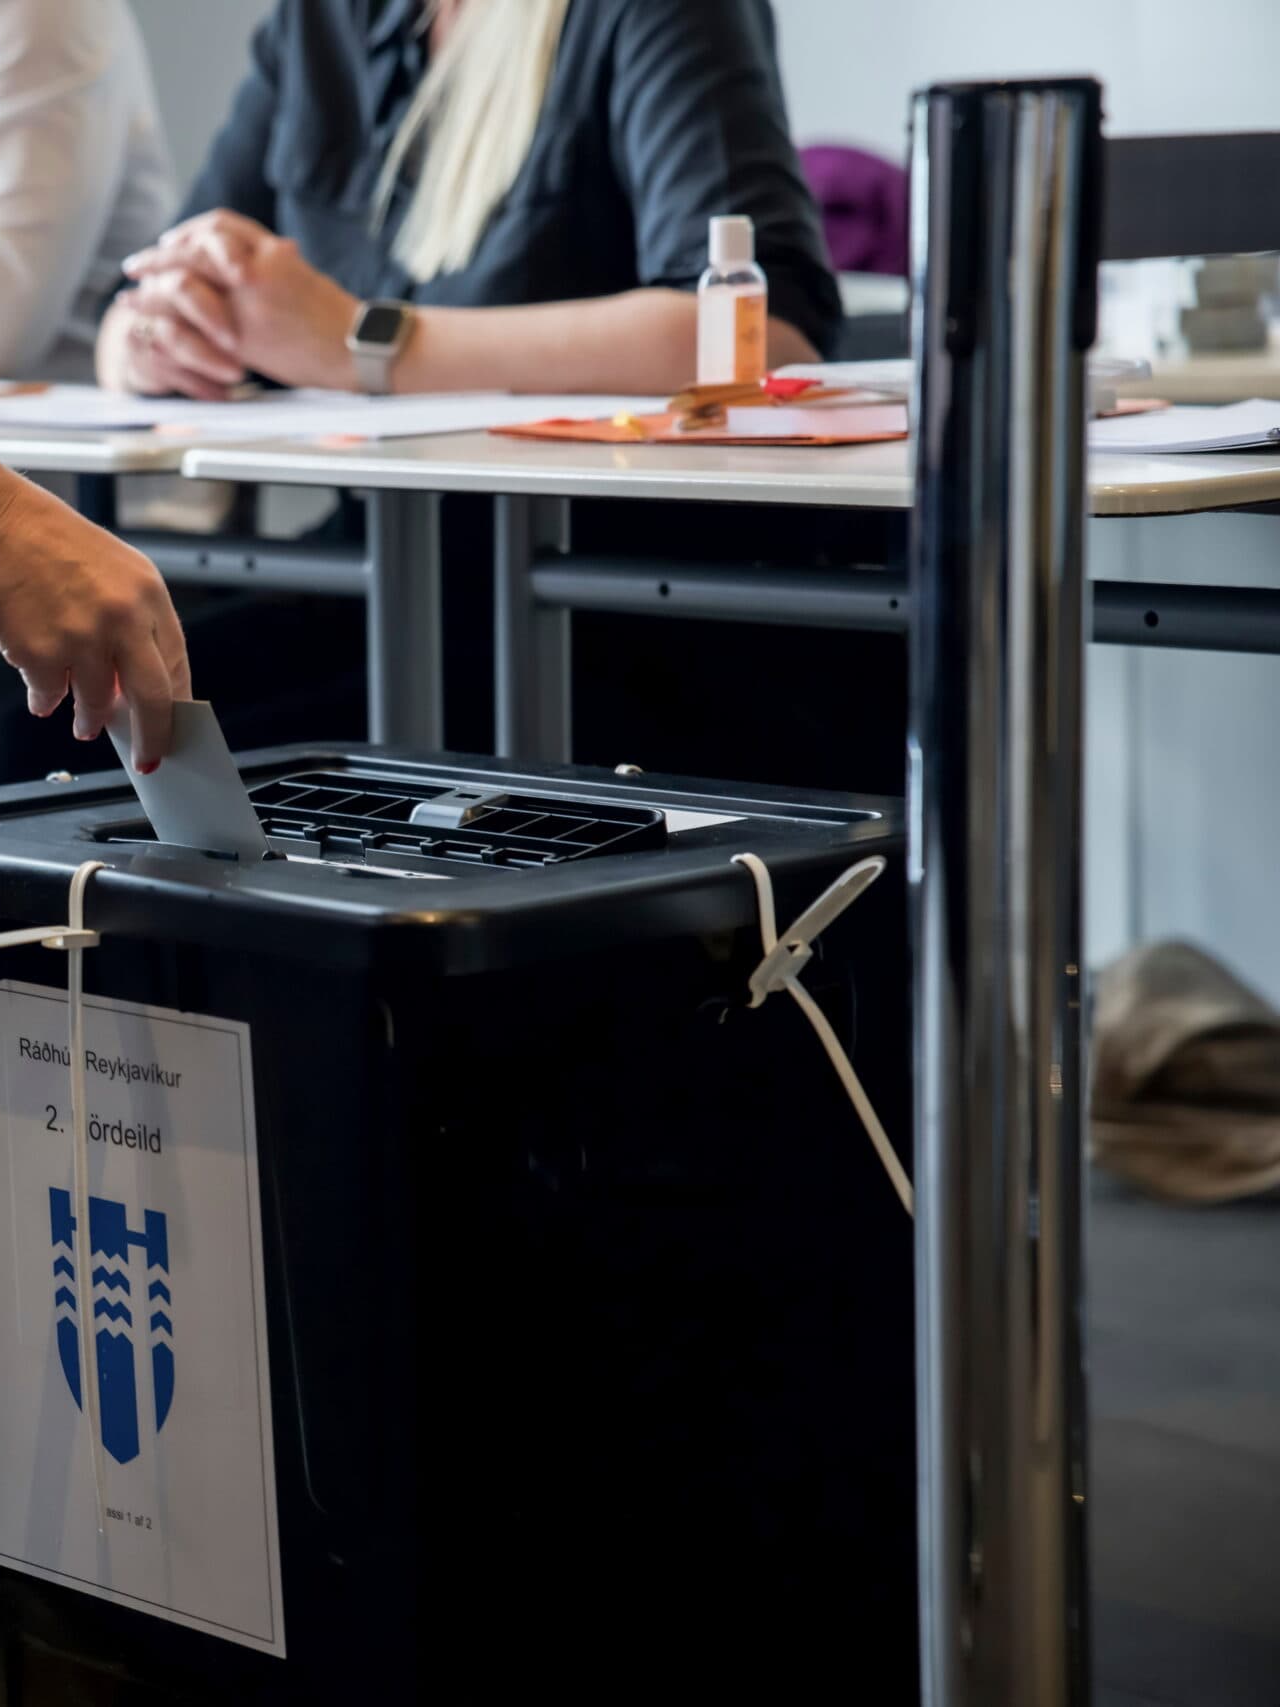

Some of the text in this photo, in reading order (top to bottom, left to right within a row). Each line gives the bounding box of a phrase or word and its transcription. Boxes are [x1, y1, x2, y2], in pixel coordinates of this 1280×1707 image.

[19, 1037, 182, 1089] Ráðhú Reykjavíkur
[45, 1104, 162, 1154] 2. ördeild
[106, 1507, 124, 1521] assi
[146, 1517, 153, 1530] 2
